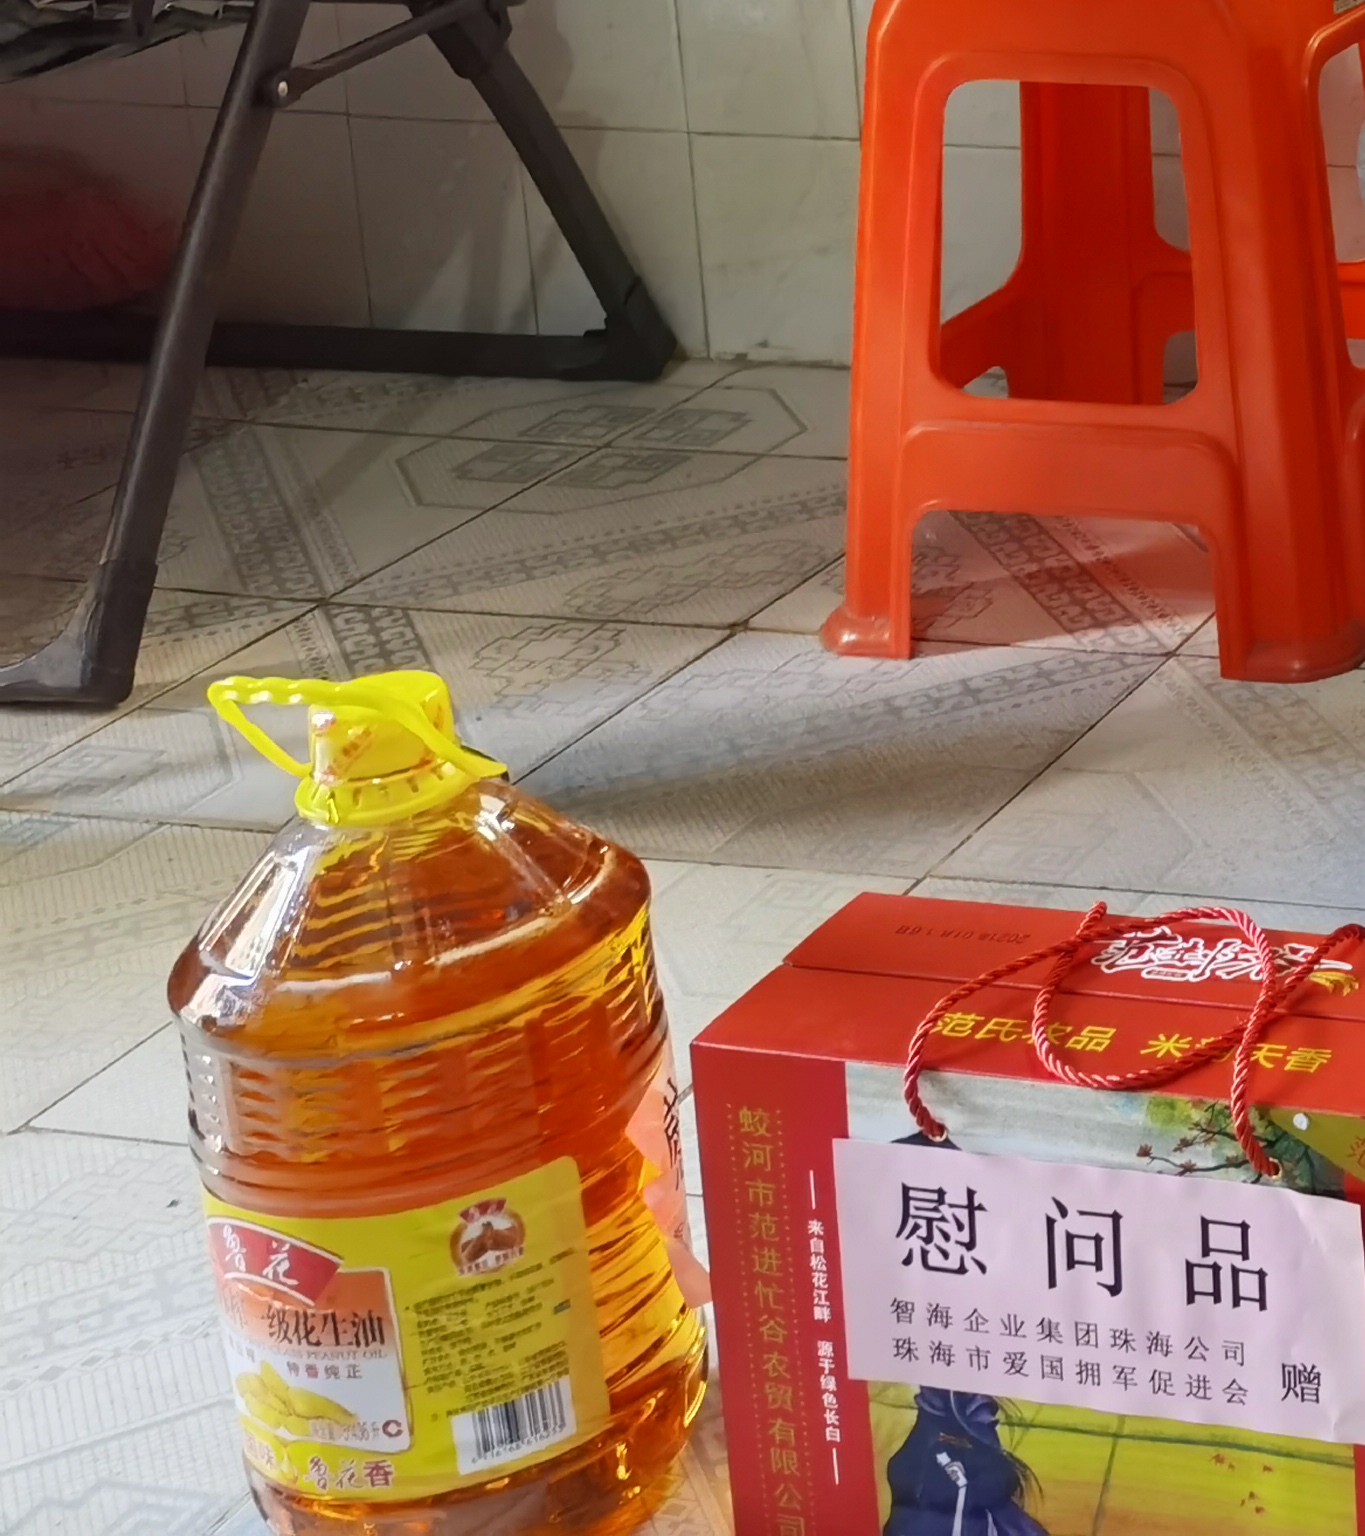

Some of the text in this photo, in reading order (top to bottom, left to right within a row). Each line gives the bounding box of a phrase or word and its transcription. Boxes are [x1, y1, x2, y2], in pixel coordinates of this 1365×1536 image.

[807, 1219, 832, 1323] 来自松花江畔
[895, 1181, 1270, 1312] 慰问品
[890, 1296, 1247, 1368] 智海企业集团珠海公司
[891, 1336, 1250, 1407] 珠海市爱国拥军促进会
[1279, 1362, 1323, 1405] 赠
